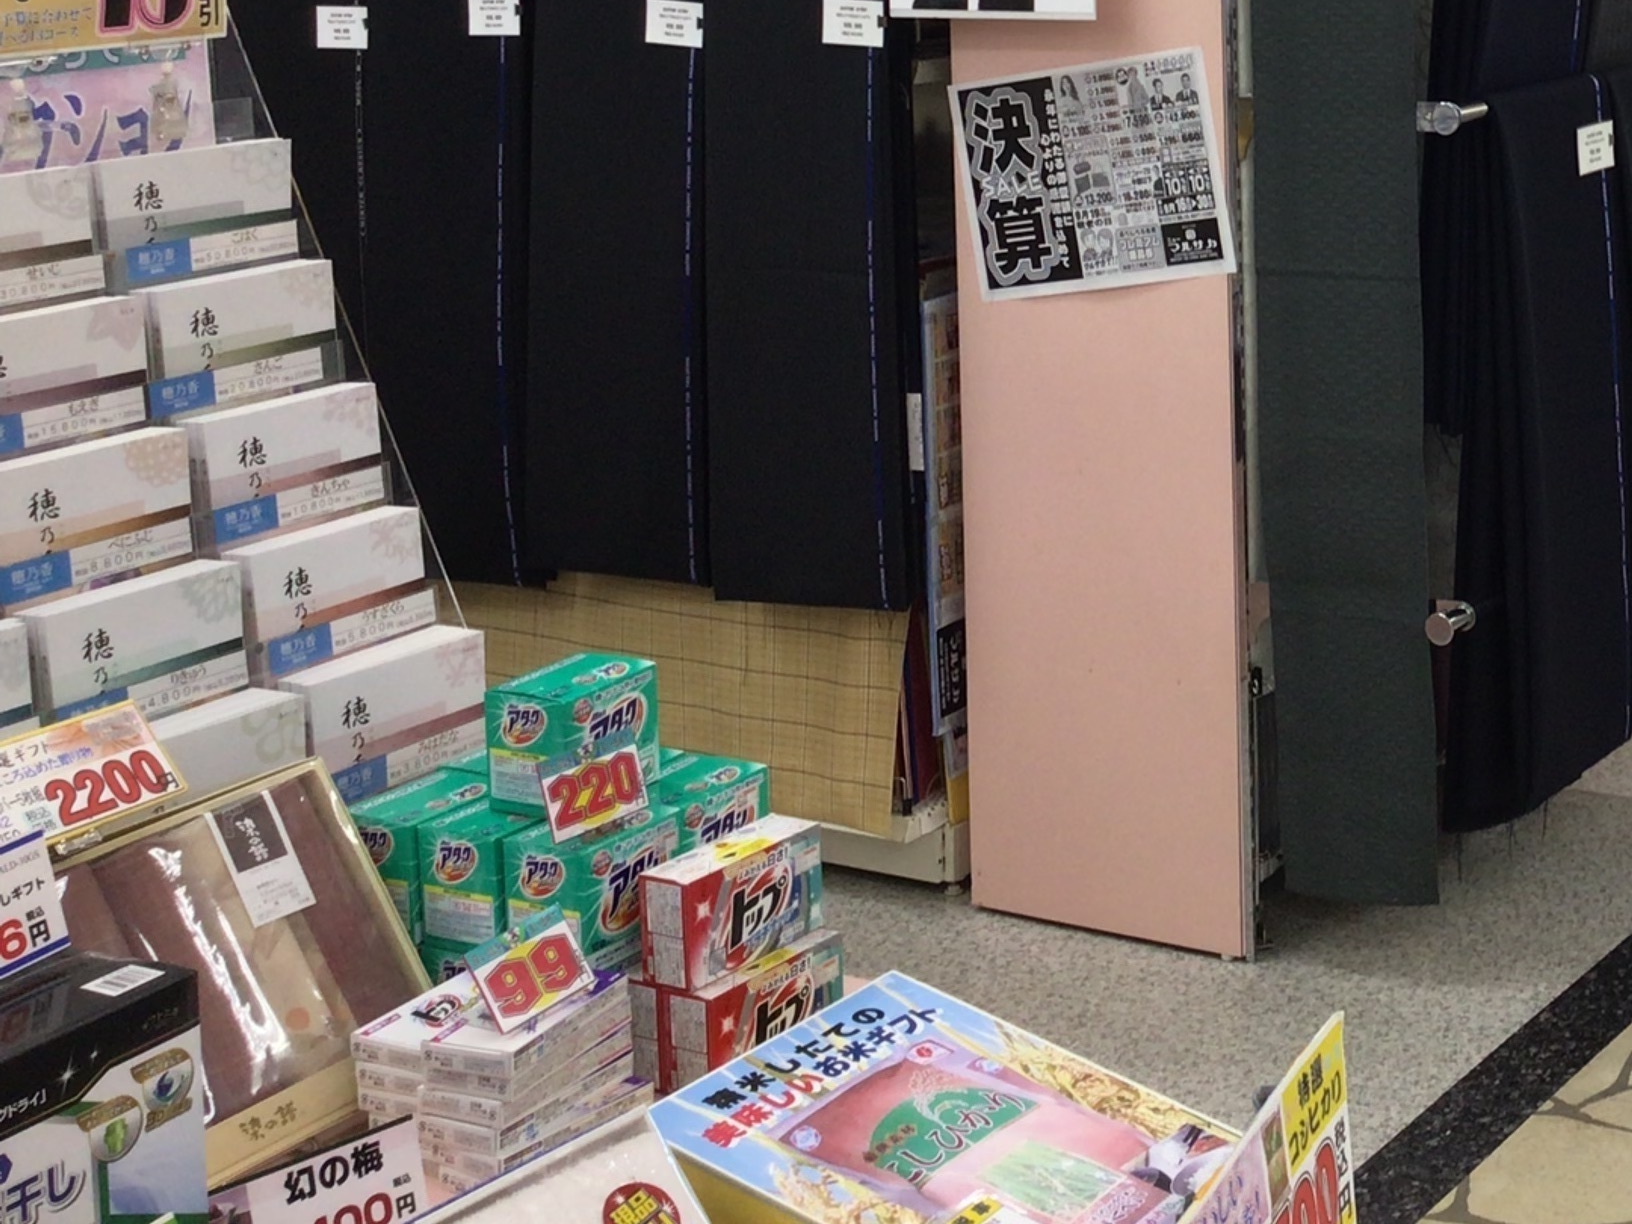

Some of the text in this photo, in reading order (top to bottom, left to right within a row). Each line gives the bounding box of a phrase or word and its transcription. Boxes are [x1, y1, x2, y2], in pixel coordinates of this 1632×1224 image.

[972, 97, 1035, 173] 決
[133, 180, 164, 244] 穂乃
[979, 172, 1043, 199] SALE
[985, 194, 1053, 275] 算
[190, 307, 219, 370] 穂乃
[237, 435, 269, 498] 穂乃
[28, 488, 62, 555] 穂乃
[283, 566, 313, 631] 穂乃
[81, 628, 115, 695] 穂乃
[341, 696, 372, 764] 穂乃
[547, 751, 640, 832] 220
[29, 919, 51, 948] 円
[730, 874, 788, 949] トップ
[484, 933, 582, 1018] 99
[703, 1006, 944, 1149] 美味しいお米ギフト
[1289, 1070, 1344, 1167] コシヒカリ
[284, 1141, 384, 1205] 幻の梅
[396, 1191, 418, 1219] 円
